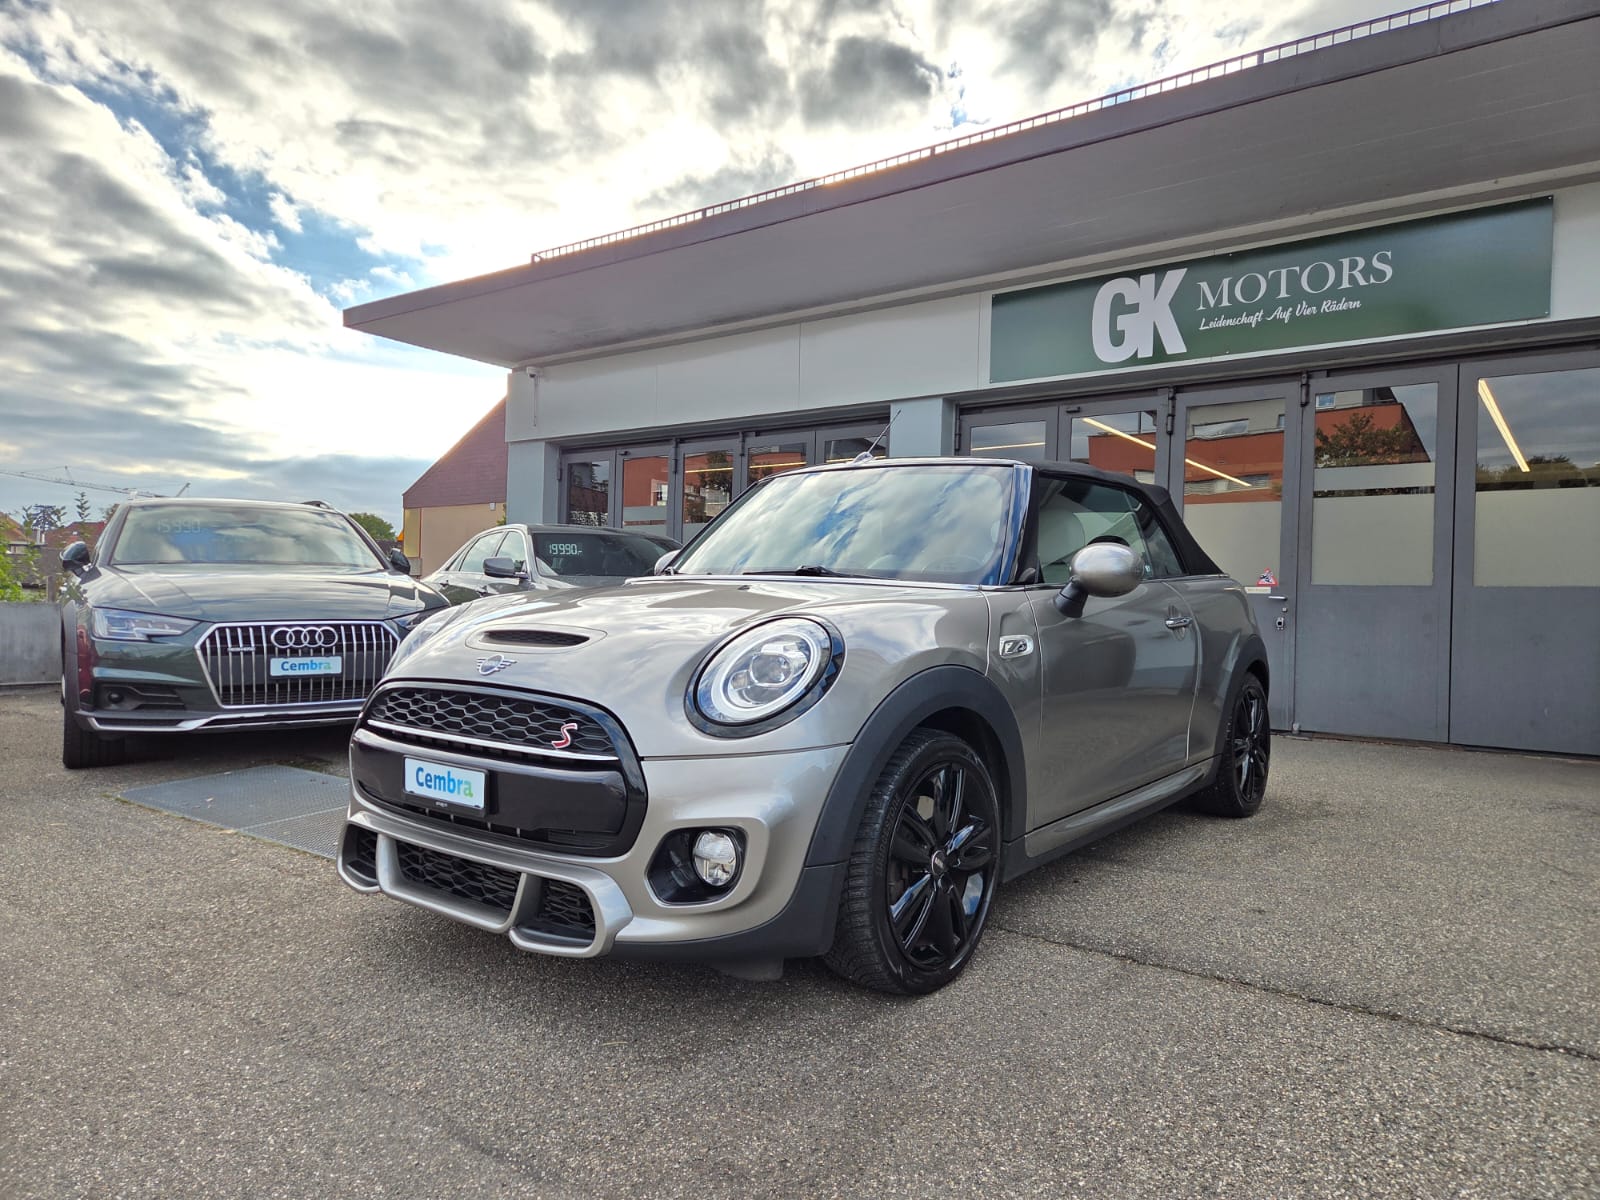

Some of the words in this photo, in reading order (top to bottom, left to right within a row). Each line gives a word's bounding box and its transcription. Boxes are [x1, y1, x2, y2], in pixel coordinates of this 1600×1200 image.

[1091, 267, 1188, 363] GK
[1196, 250, 1394, 311] MOTORS
[1199, 309, 1264, 330] Leidenschaft
[1265, 306, 1293, 323] Auf
[1295, 300, 1318, 317] Vier
[1320, 297, 1362, 313] Rädern
[280, 659, 333, 672] Cembra
[415, 766, 474, 798] Cembra
